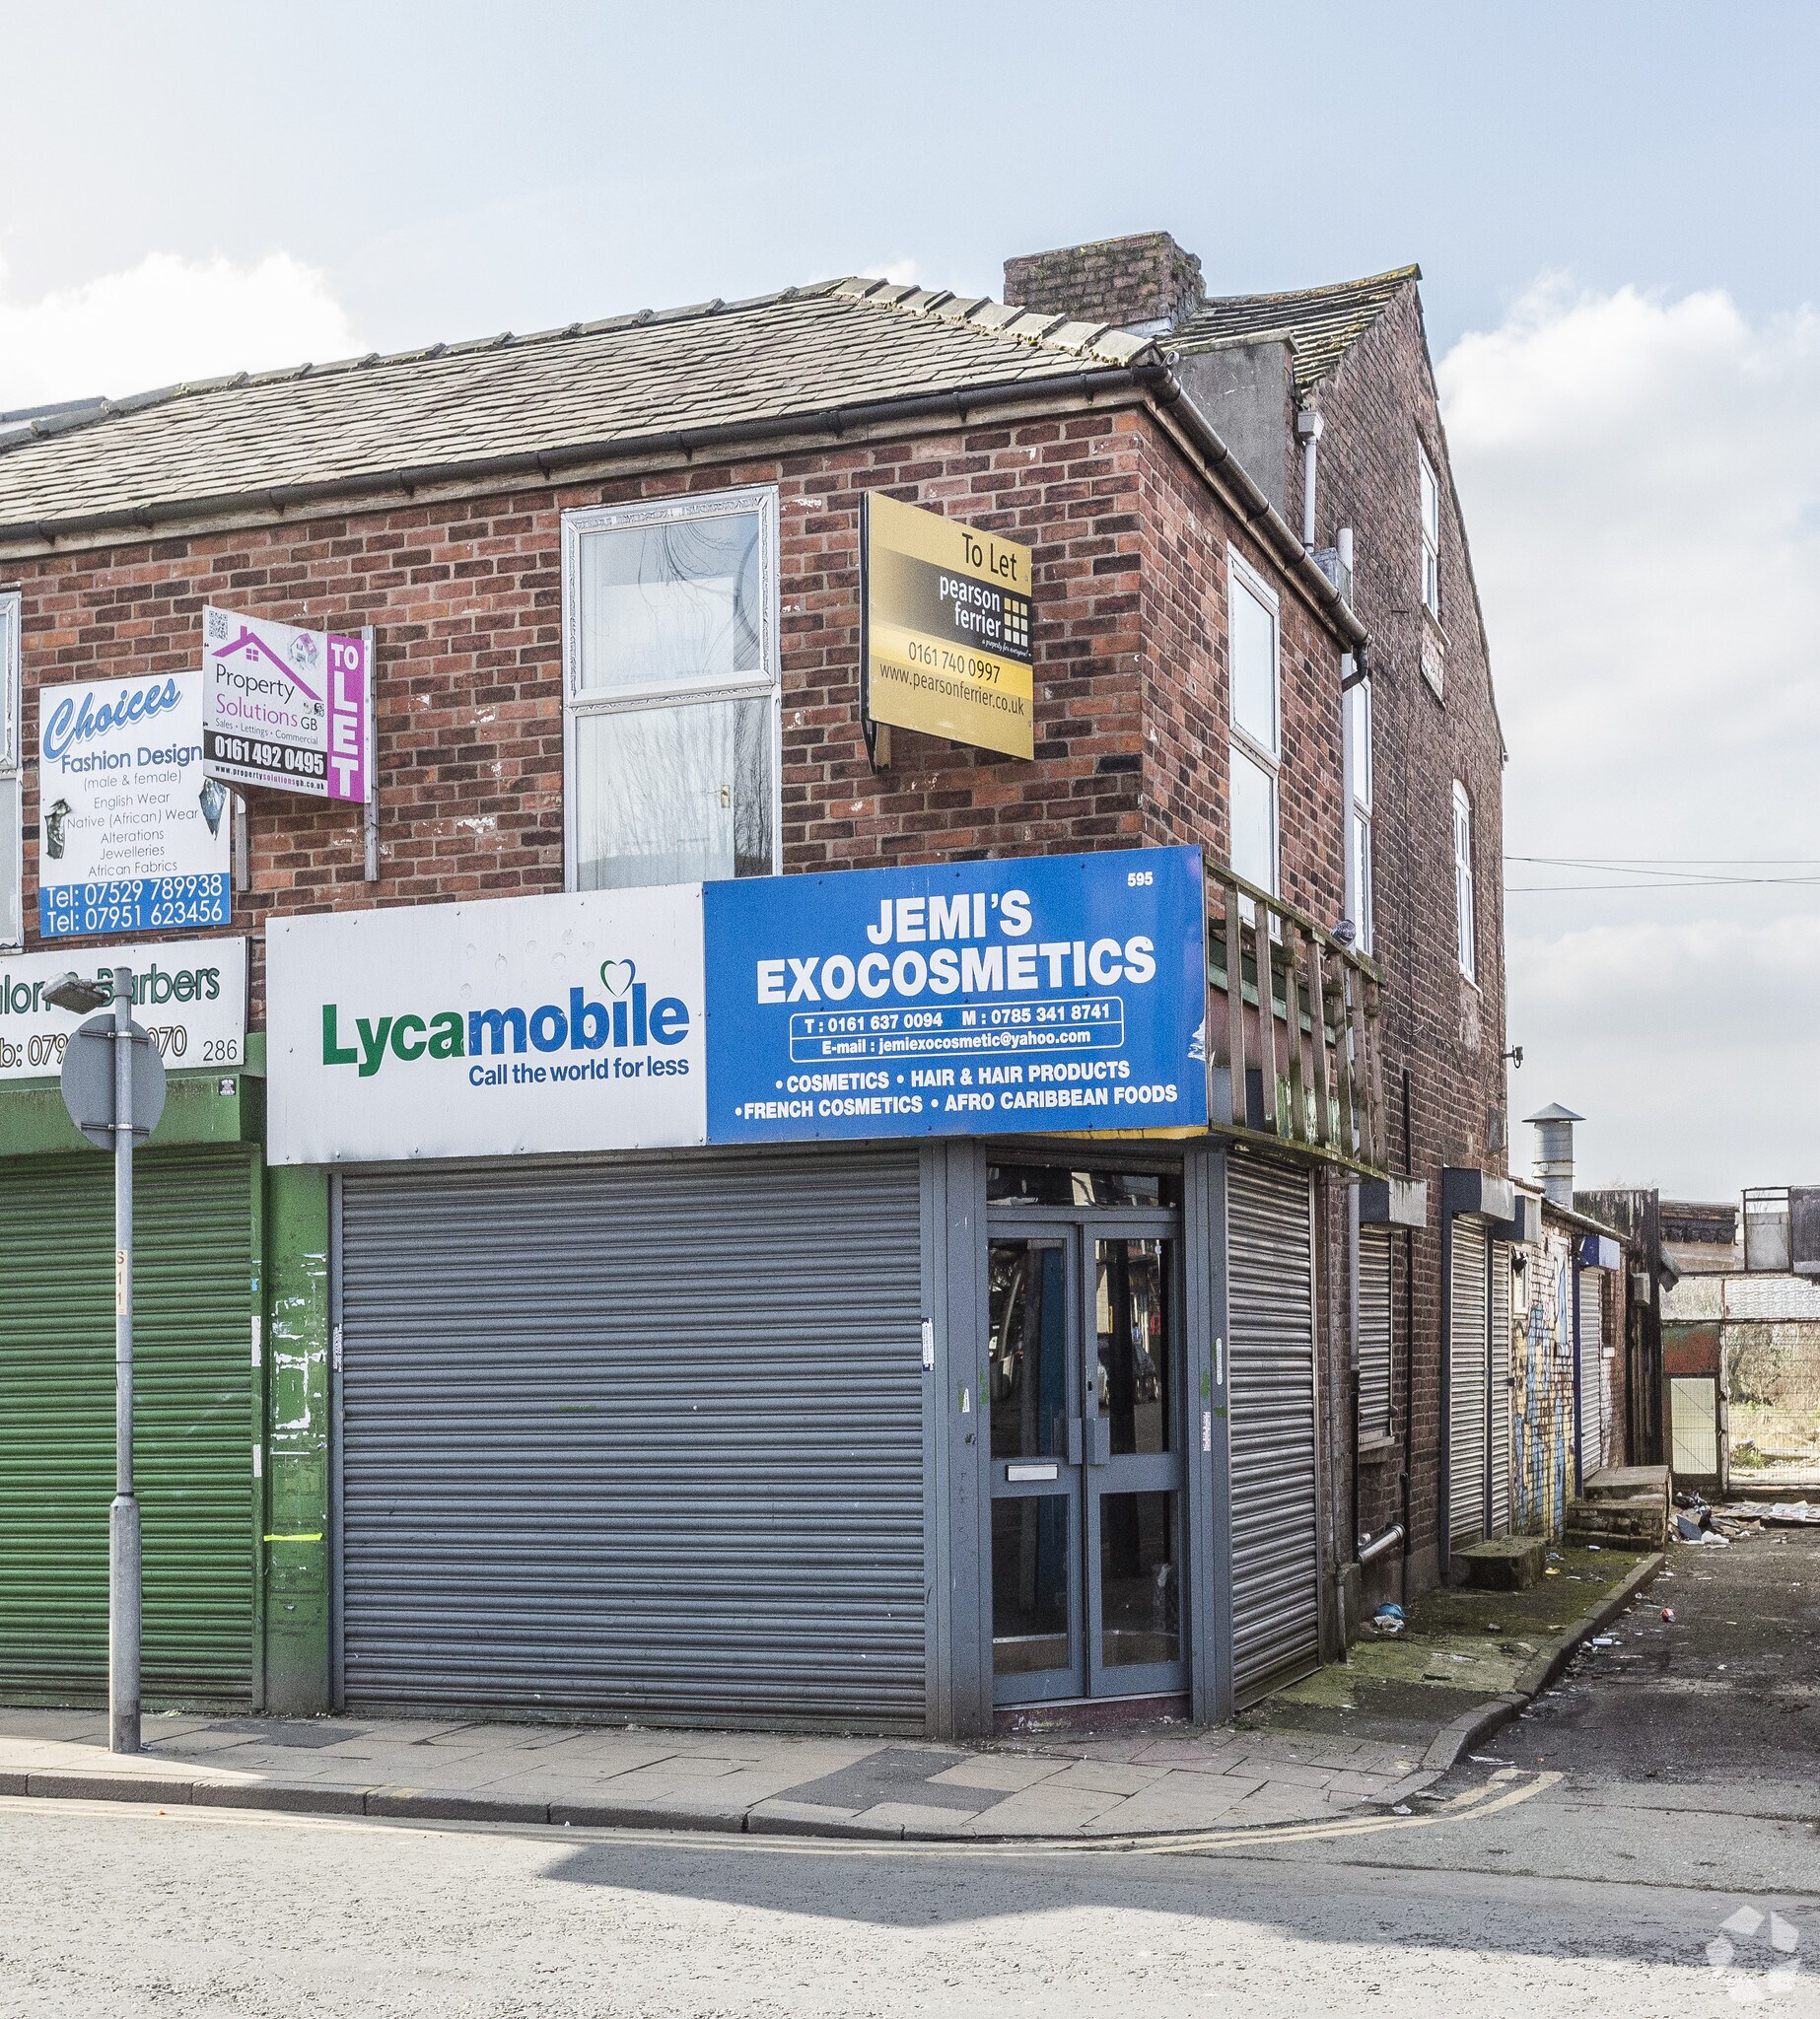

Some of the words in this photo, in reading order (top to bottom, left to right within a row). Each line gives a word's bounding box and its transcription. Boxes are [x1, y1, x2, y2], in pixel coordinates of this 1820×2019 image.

[961, 532, 983, 568] To
[990, 542, 1017, 582] Let
[940, 575, 1000, 612] pearson
[954, 601, 1001, 638] ferrier
[331, 643, 359, 670] TO
[908, 641, 939, 665] 0161
[942, 651, 965, 674] 740
[968, 660, 1001, 684] 0997
[216, 663, 295, 705] Property
[879, 663, 1024, 716] www.pearsonferrier.co.uk
[43, 677, 181, 761] Choices
[216, 693, 298, 728] Solutions
[300, 716, 317, 731] GB
[215, 718, 233, 730] Sales
[241, 723, 268, 737] Lettings
[275, 730, 318, 745] Commercial
[331, 670, 359, 798] LET
[61, 750, 131, 774] Fashion
[215, 734, 250, 763] 0161
[251, 743, 282, 769] 492
[284, 749, 324, 775] 0495
[84, 776, 117, 792] (male
[122, 774, 130, 786] &
[134, 770, 181, 785] female)
[215, 764, 324, 790] www.propertysolutionsgb.co.uk
[67, 815, 105, 829] Native
[109, 809, 162, 828] (African)
[165, 808, 199, 820] Wear
[94, 794, 133, 812] English
[137, 793, 171, 804] Wear
[100, 844, 165, 860] Jewelleries
[101, 829, 165, 845] Alterations
[88, 863, 131, 877] African
[134, 861, 178, 874] Fabrics
[1127, 871, 1154, 887] 595
[46, 885, 79, 908] Tel:
[85, 879, 143, 905] 07529
[150, 873, 223, 901] 789938
[47, 909, 80, 933] Tel:
[85, 904, 141, 931] 07951
[150, 899, 223, 926] 623456
[867, 889, 1033, 945] JEMI'S
[98, 963, 221, 1007] Brbers
[757, 936, 1156, 1005] EXOCOSMETICS
[322, 981, 690, 1078] Lycamobile
[827, 1016, 866, 1033] 0161
[870, 1014, 899, 1030] 637
[903, 1012, 944, 1029] 0094
[991, 1008, 1031, 1024] 0785
[1036, 1006, 1065, 1021] 341
[1071, 1004, 1109, 1020] 8741
[202, 1039, 238, 1062] 286
[822, 1039, 867, 1055] E-mail
[878, 1030, 1091, 1055] jemiexocosmetic@yahoo.com
[468, 1063, 508, 1086] Call
[512, 1063, 547, 1084] the
[550, 1058, 608, 1082] world
[613, 1057, 644, 1079] for
[647, 1055, 689, 1078] less
[786, 1072, 889, 1093] COSMETICS
[911, 1069, 954, 1087] HAIR
[959, 1068, 973, 1085] &
[978, 1065, 1023, 1084] HAIR
[1028, 1060, 1131, 1082] PRODUCTS
[743, 1100, 813, 1120] FRENCH
[818, 1095, 923, 1117] COSMETICS
[945, 1092, 995, 1112] AFRO
[1000, 1087, 1108, 1109] CARIBBEAN
[1113, 1083, 1178, 1104] FOODS
